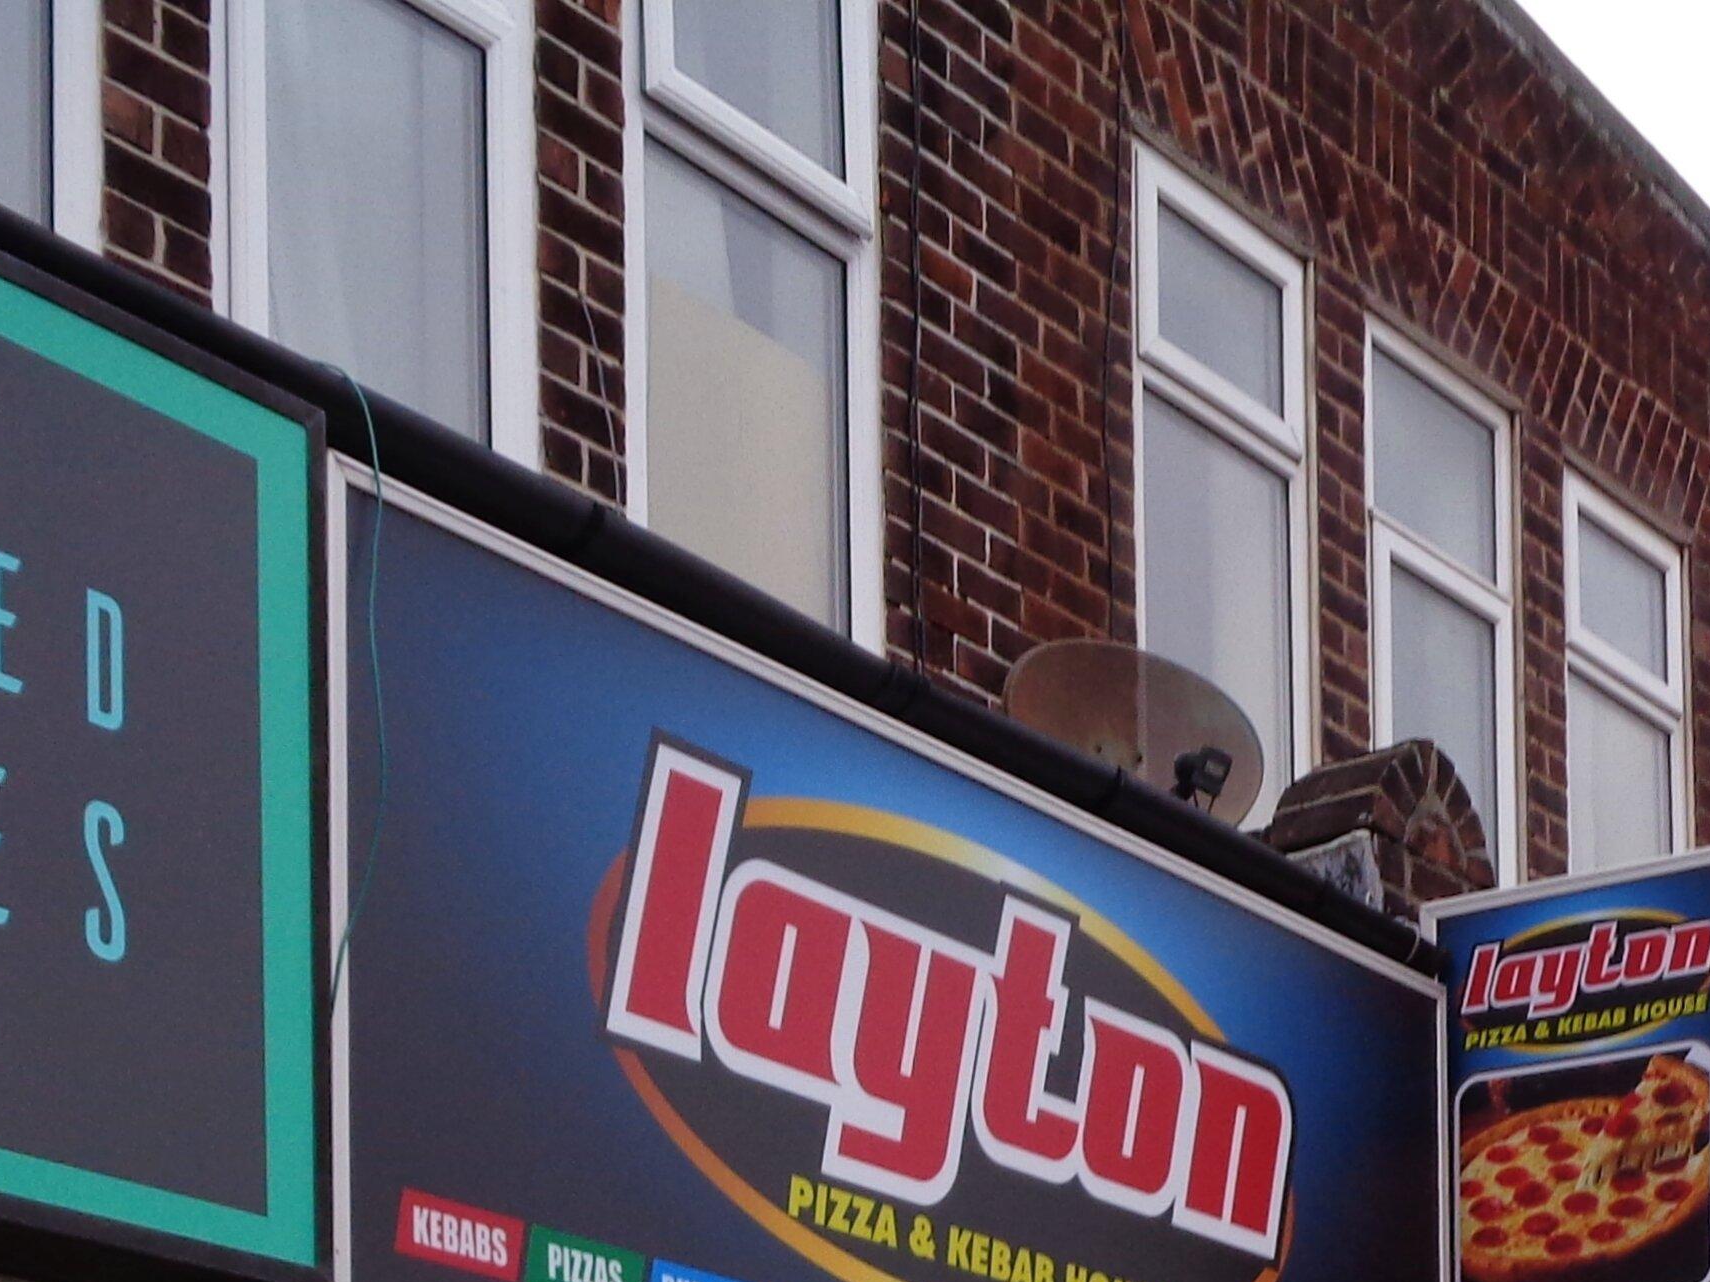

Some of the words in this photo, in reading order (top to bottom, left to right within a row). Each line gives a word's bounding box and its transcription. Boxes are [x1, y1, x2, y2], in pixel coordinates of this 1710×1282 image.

[609, 742, 1293, 1258] layton
[1465, 1023, 1527, 1050] PIZZA
[1534, 1020, 1550, 1041] &
[1557, 1009, 1625, 1038] KEBAB
[1633, 994, 1708, 1027] HOUSE
[411, 1205, 508, 1267] KEBABS
[788, 1174, 898, 1248] PIZZA
[908, 1220, 936, 1260] &
